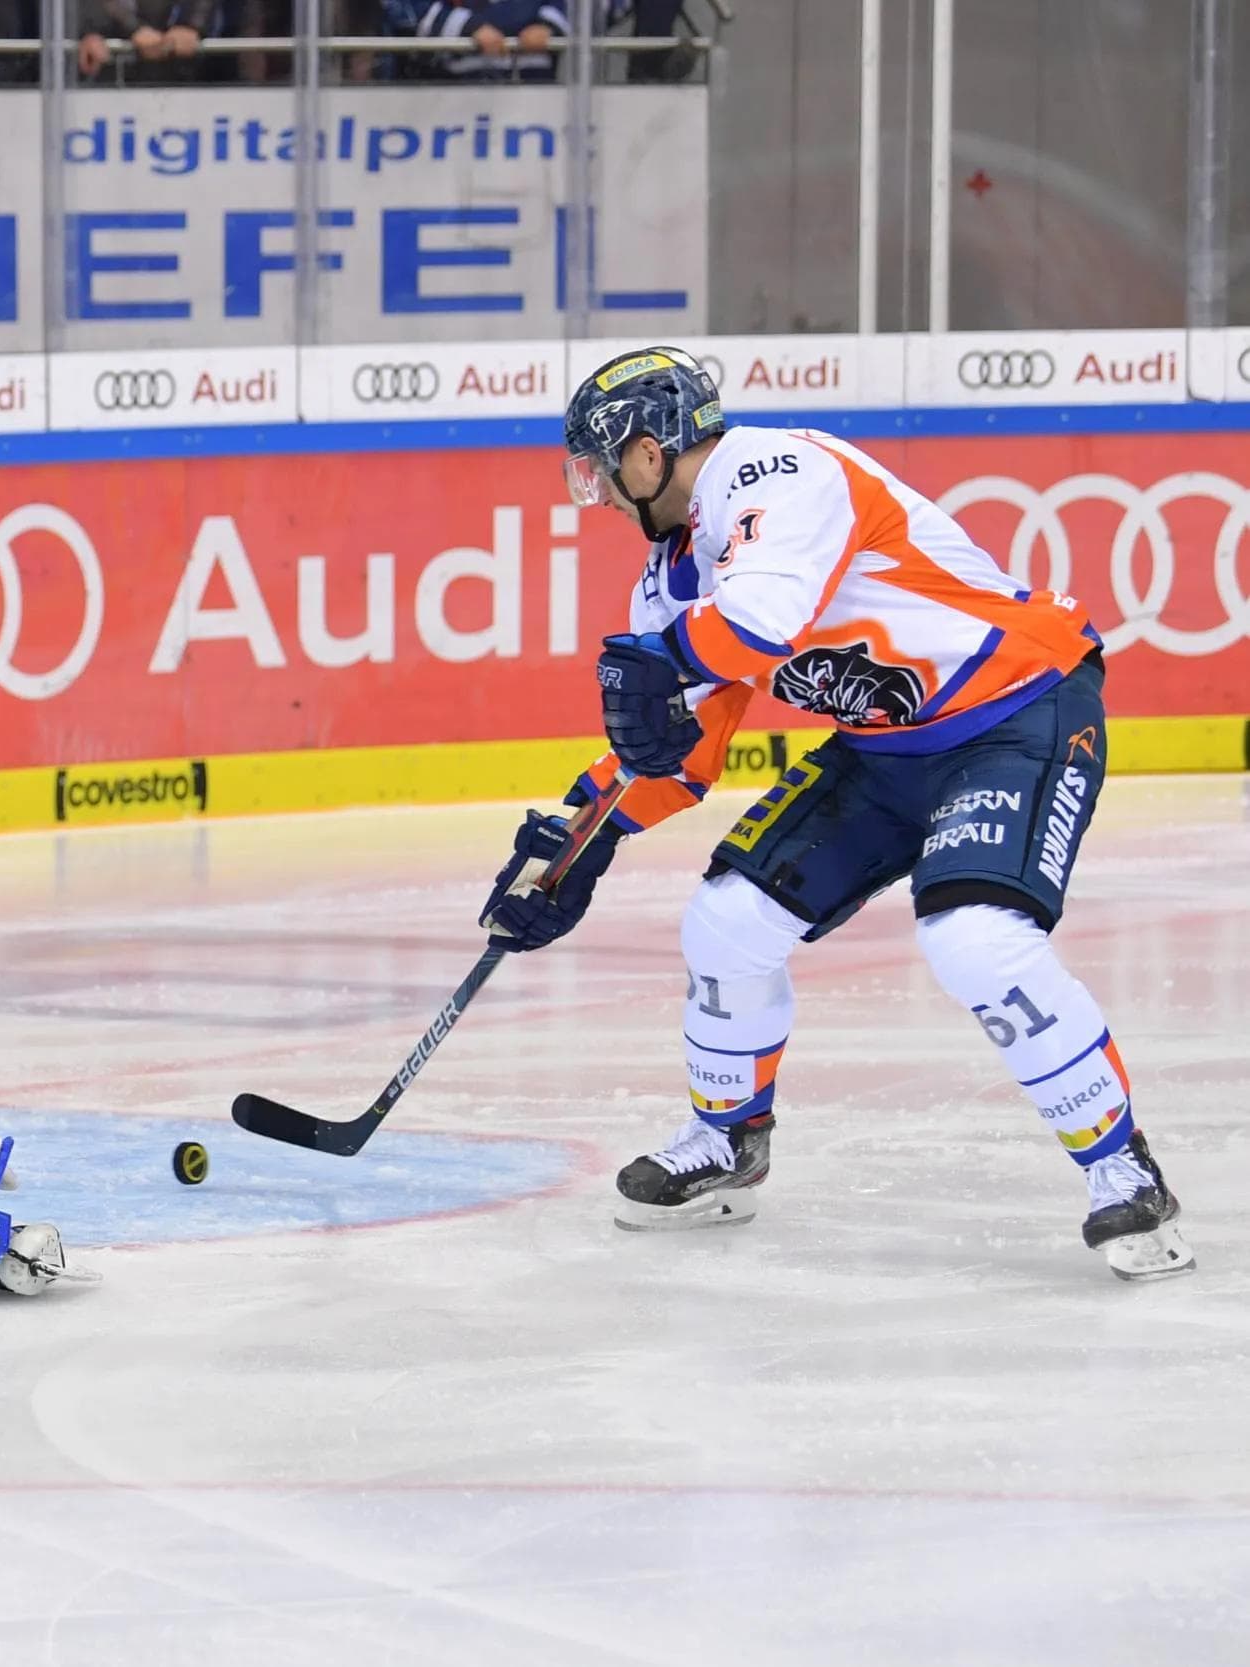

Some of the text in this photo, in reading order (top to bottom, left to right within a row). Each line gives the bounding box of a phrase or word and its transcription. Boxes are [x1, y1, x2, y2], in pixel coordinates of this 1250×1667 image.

[456, 364, 549, 398] Audi
[606, 356, 656, 385] EDEKA
[742, 356, 840, 389] Audi
[1075, 351, 1177, 384] Audi
[190, 371, 278, 406] Audi
[149, 505, 580, 673] Audi
[922, 821, 1006, 859] BRÄU
[1038, 766, 1088, 891] SATURN
[970, 985, 1059, 1048] 61
